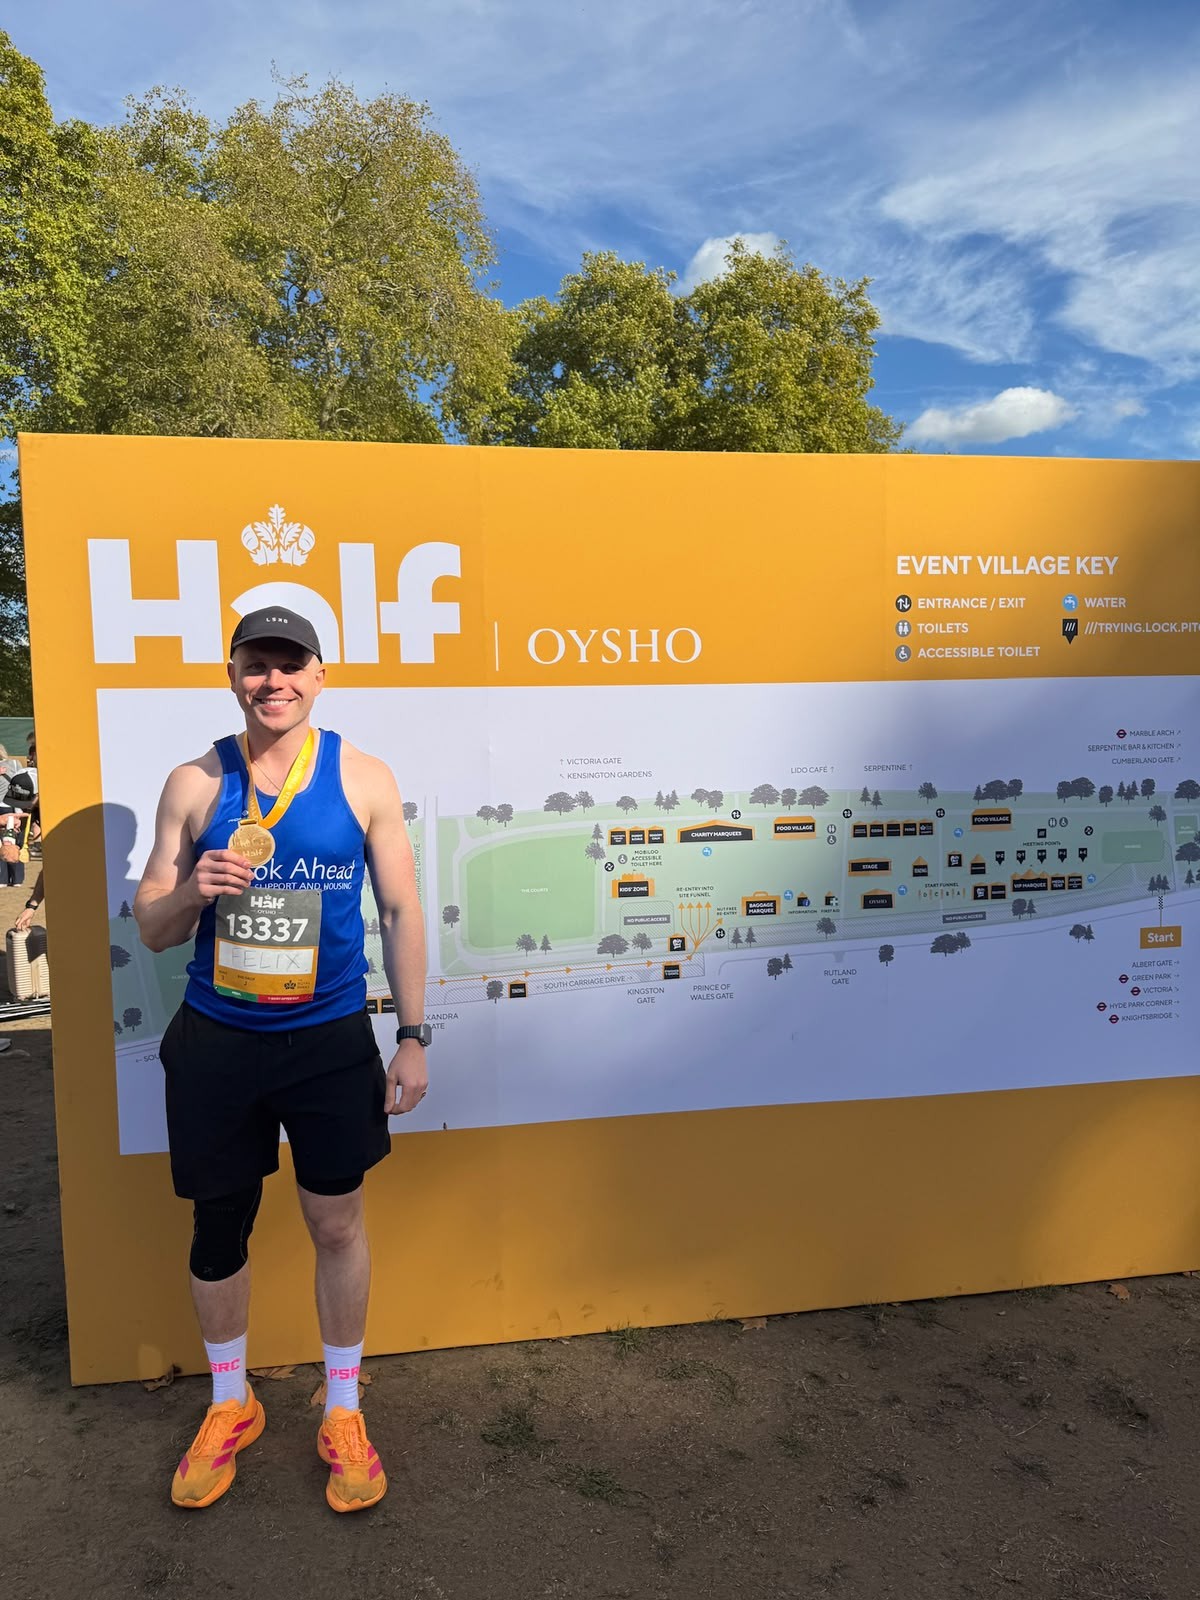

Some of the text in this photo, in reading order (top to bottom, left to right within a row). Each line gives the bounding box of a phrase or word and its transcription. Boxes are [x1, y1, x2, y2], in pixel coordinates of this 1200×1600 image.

[896, 555, 1119, 575] EVENT VILLAGE KEY
[917, 597, 988, 609] ENTRANCE
[998, 597, 1026, 609] EXIT
[1084, 597, 1127, 608] WATER
[917, 622, 969, 634] TOILETS
[1084, 621, 1200, 635] ///TRYING.LOCK.PIT
[527, 627, 702, 665] OYSHO
[917, 646, 1041, 659] ACCESSIBLE TOILET
[1087, 744, 1127, 752] SERPENTINE
[566, 757, 622, 765] VICTORIA GATE
[1112, 757, 1157, 765] CUMBERLAND
[567, 770, 652, 779] KENSINGTON GARDENS
[254, 857, 355, 881] ok Ahead
[299, 882, 320, 890] AND
[323, 882, 352, 890] HOUSING
[250, 896, 285, 909] Half
[226, 913, 309, 942] 13337
[1147, 932, 1174, 943] Start
[232, 947, 300, 970] FELIX
[544, 975, 626, 990] SOUTH CARRIAGE DRIVE
[693, 983, 731, 992] PRINCE OF
[627, 987, 665, 997] KINGSTON
[690, 992, 734, 1001] WALES GATE
[636, 995, 656, 1004] GATE
[1121, 1013, 1173, 1021] KNIGHTSBRIDGE
[143, 1053, 160, 1062] SOU
